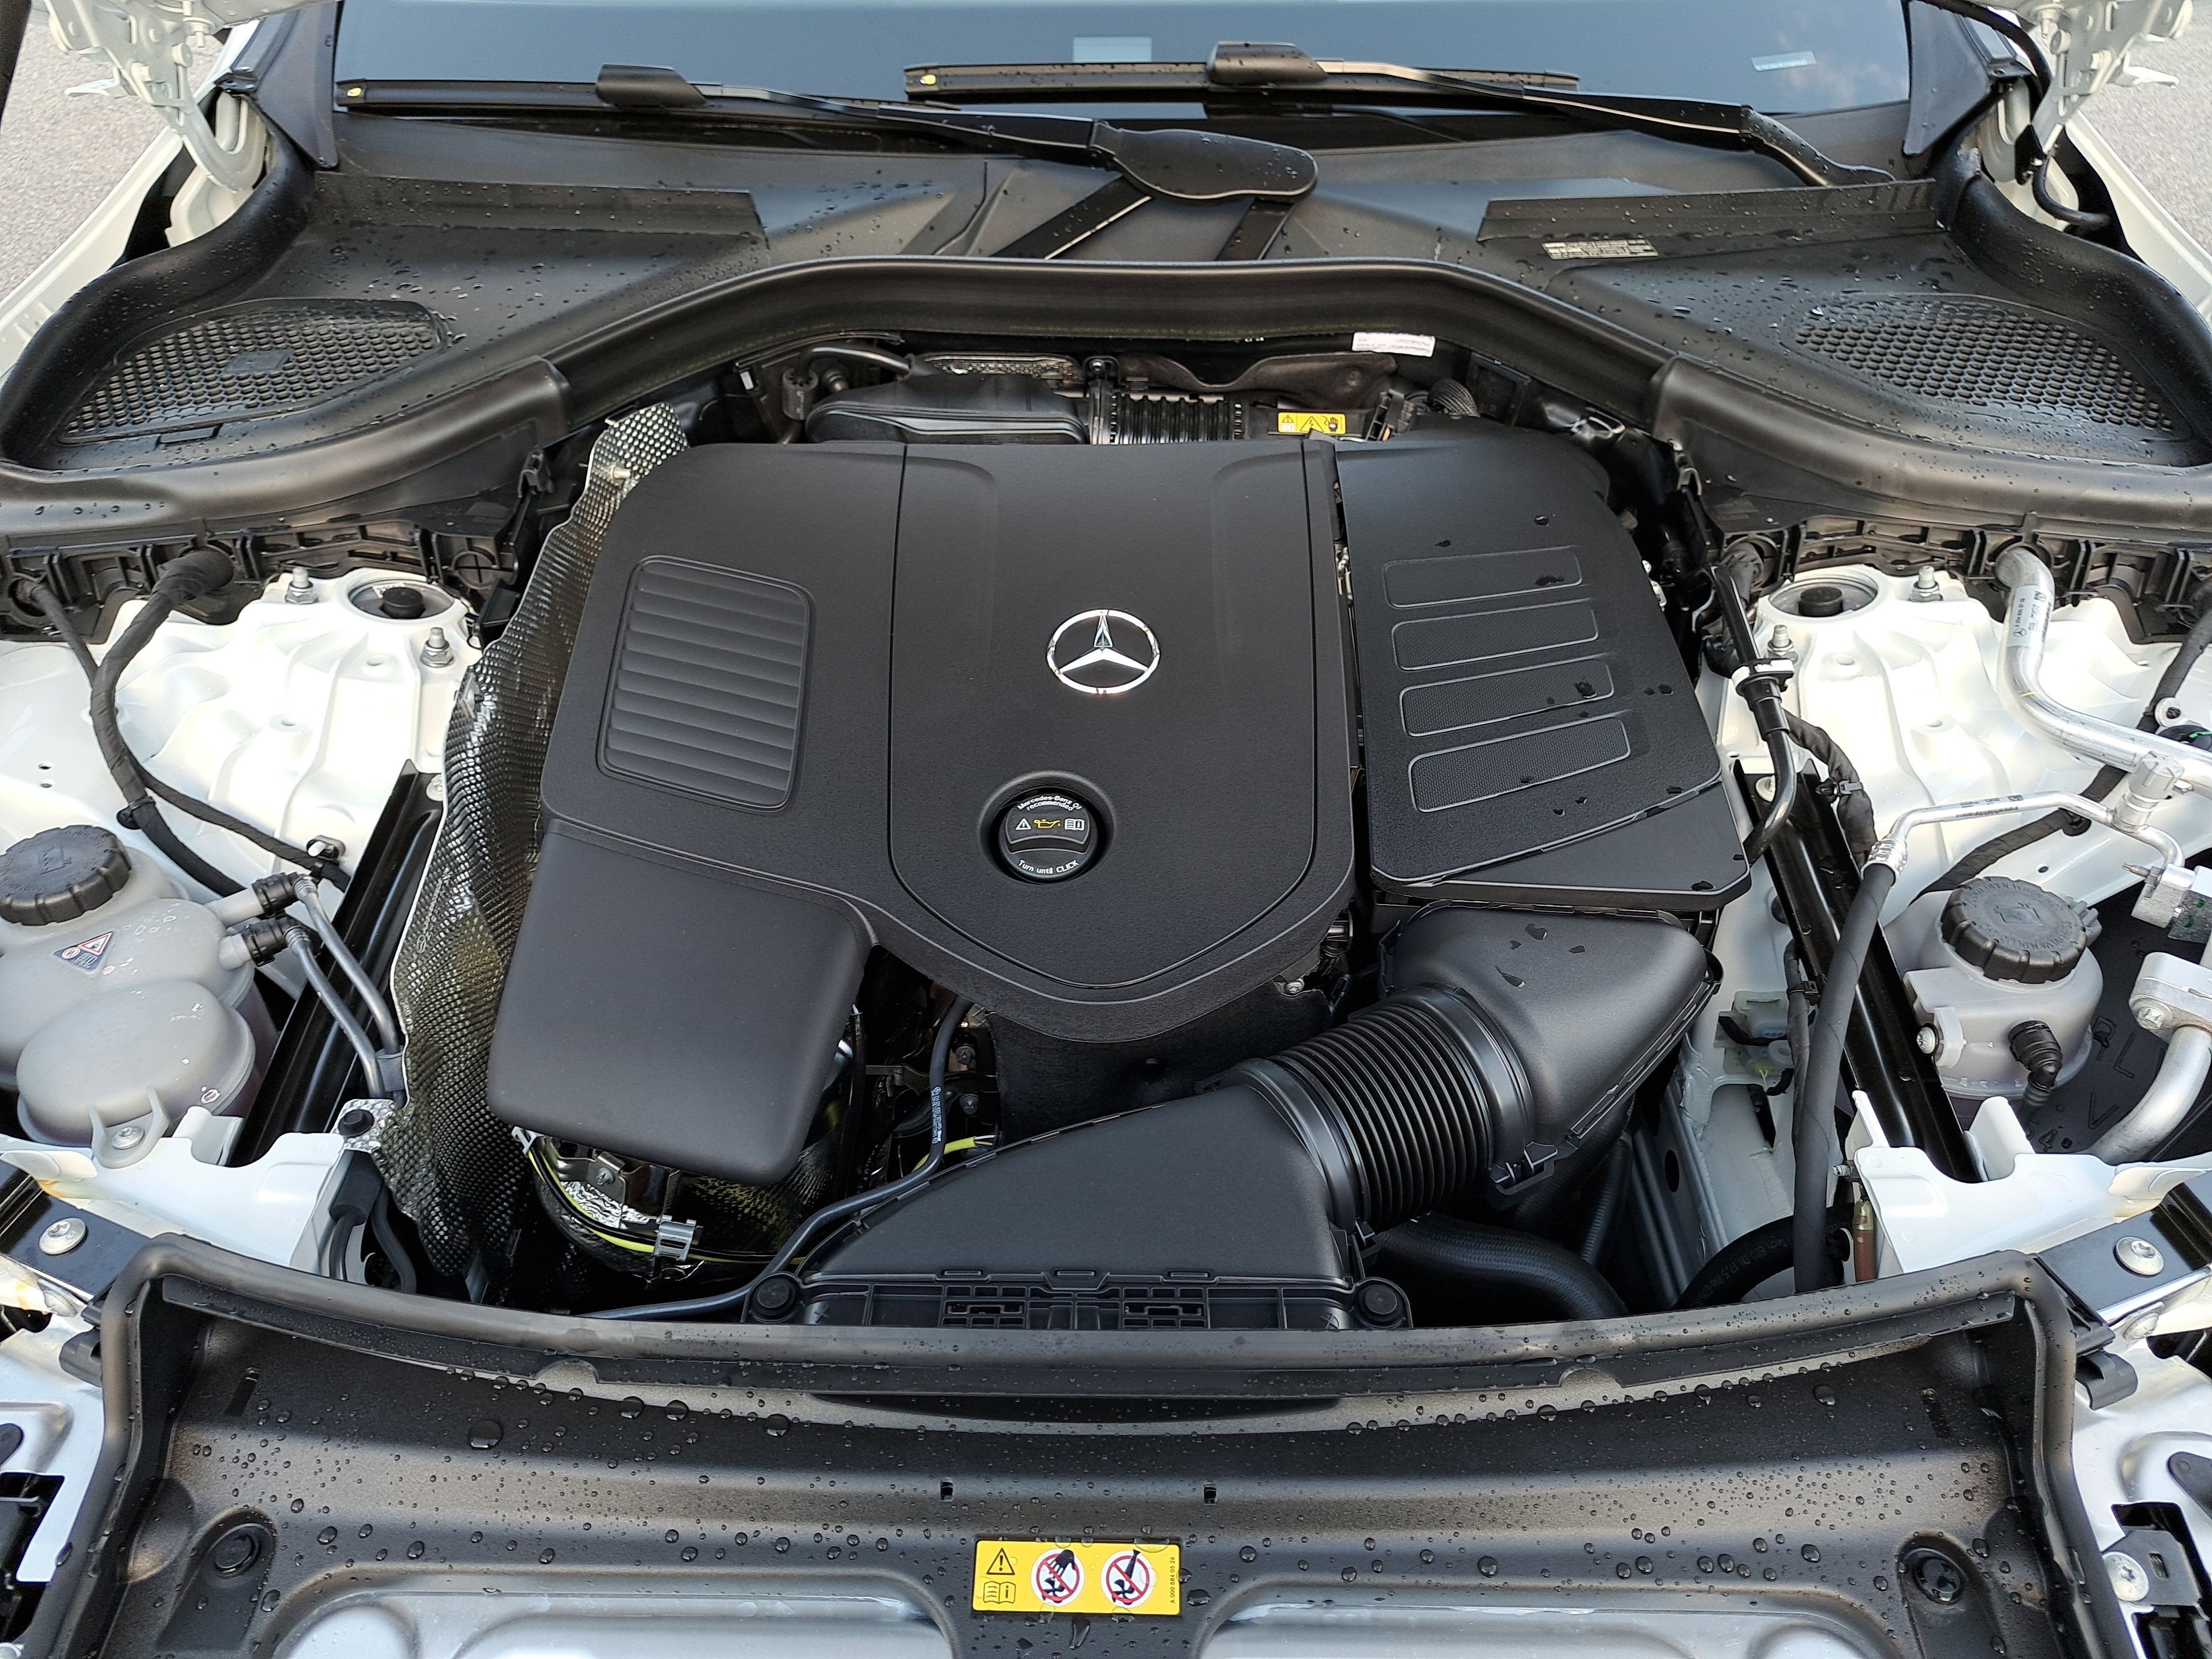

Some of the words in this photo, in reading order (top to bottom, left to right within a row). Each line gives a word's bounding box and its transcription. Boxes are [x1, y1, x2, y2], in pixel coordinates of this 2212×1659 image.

[1017, 795, 1073, 810] Mercedes-Benz
[1026, 801, 1075, 811] recommended
[1018, 859, 1034, 872] Turn
[1056, 859, 1080, 873] CLICK
